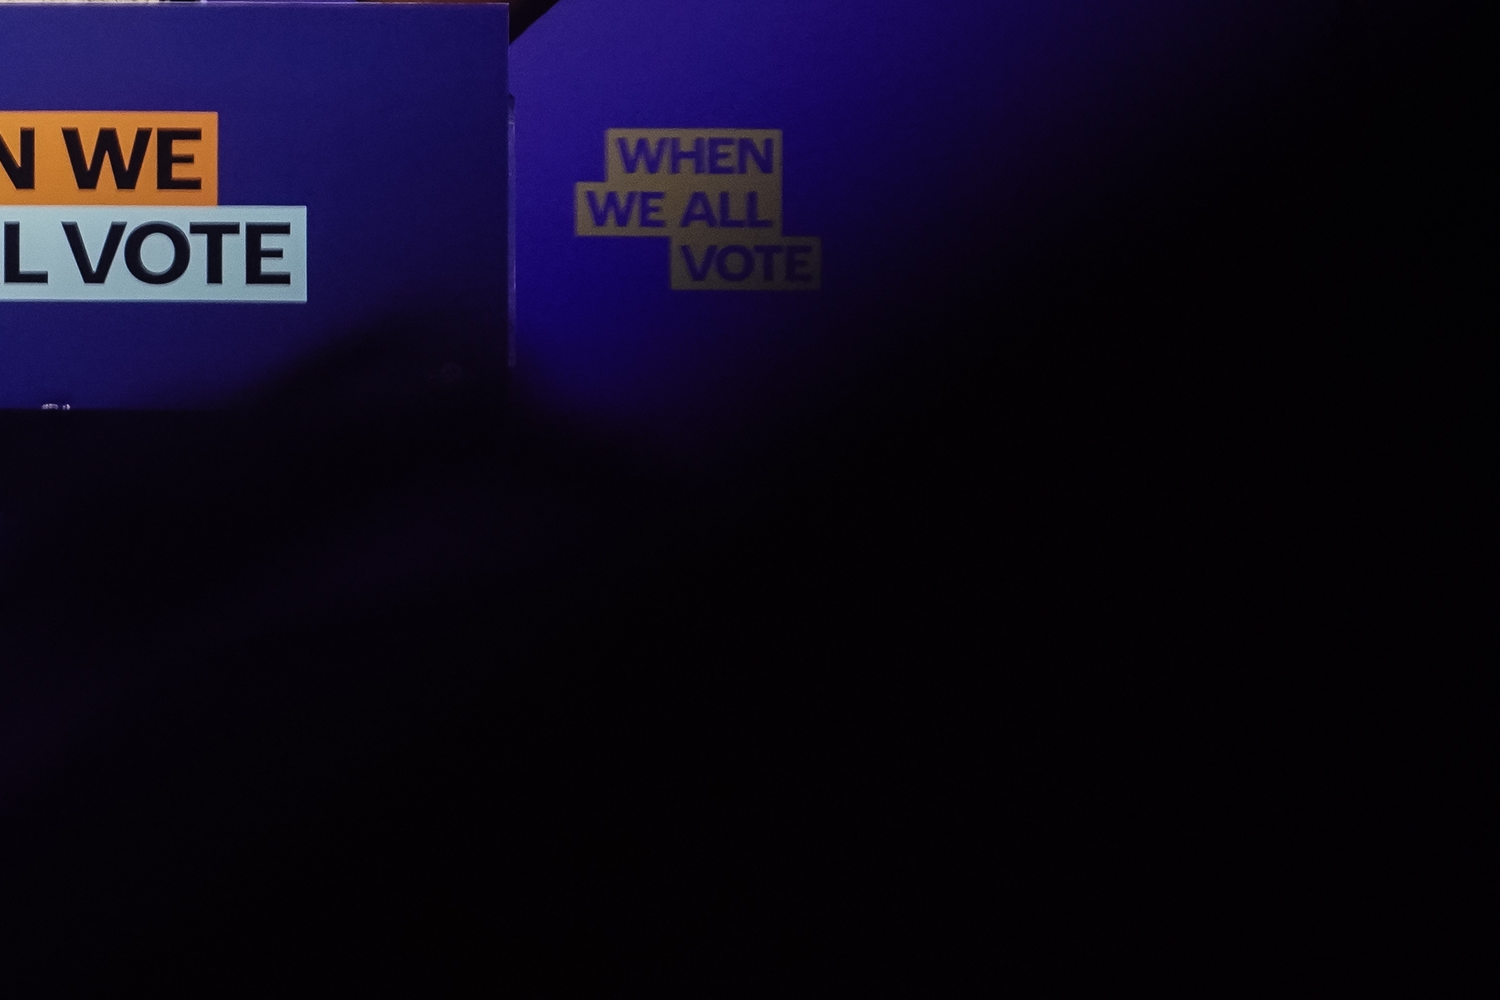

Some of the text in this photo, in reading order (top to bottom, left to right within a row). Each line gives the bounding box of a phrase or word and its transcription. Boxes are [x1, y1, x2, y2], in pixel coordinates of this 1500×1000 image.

[60, 126, 203, 191] WE
[616, 137, 773, 175] WHEN
[585, 190, 774, 228] WE ALL
[60, 220, 292, 286] VOTE
[680, 245, 812, 282] VOTE
